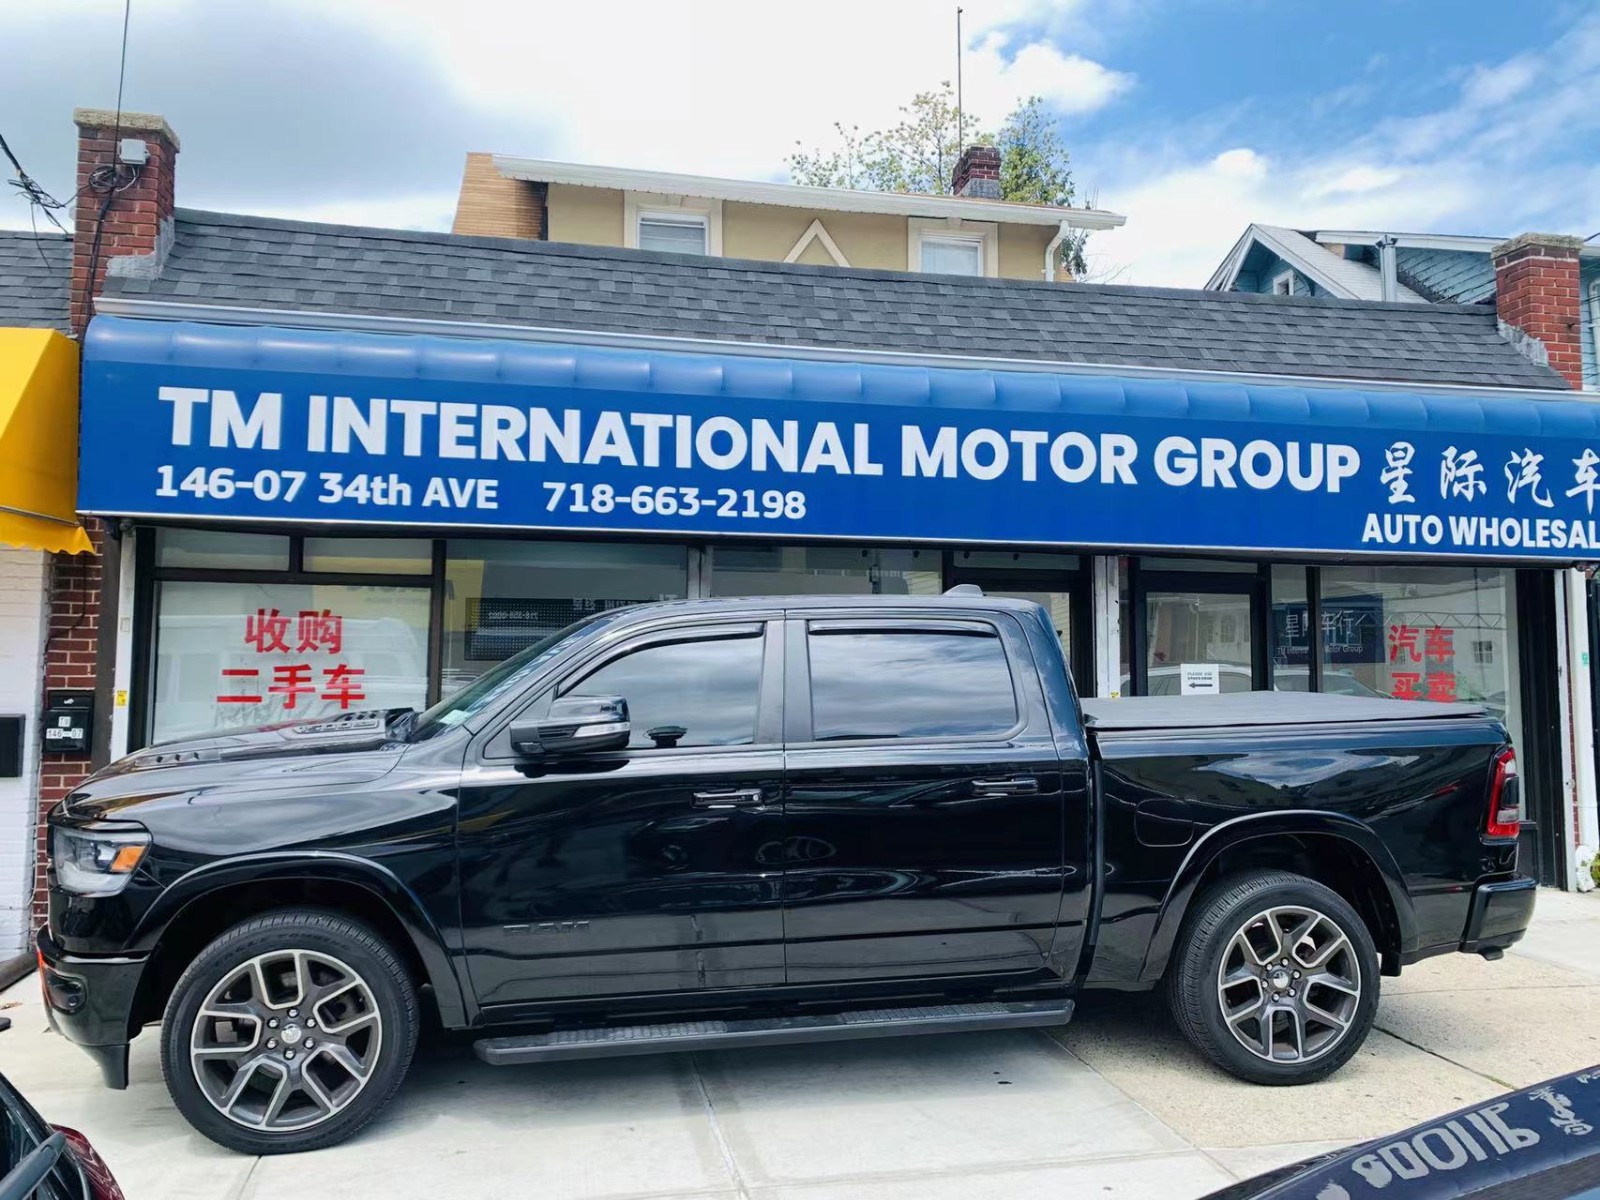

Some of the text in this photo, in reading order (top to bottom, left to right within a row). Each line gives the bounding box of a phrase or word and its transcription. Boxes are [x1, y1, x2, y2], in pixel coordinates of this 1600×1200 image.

[158, 386, 1361, 493] TM INTERNATIONAL MOTOR GROUP
[156, 465, 498, 509] 146-07 34th AVE
[543, 481, 806, 519] 718-663-2198
[1362, 513, 1600, 549] AUTO WHOLESAL
[244, 608, 343, 654] 收购
[1388, 624, 1456, 664] 汽车
[216, 664, 366, 710] 二手车
[48, 729, 82, 738] 146-07
